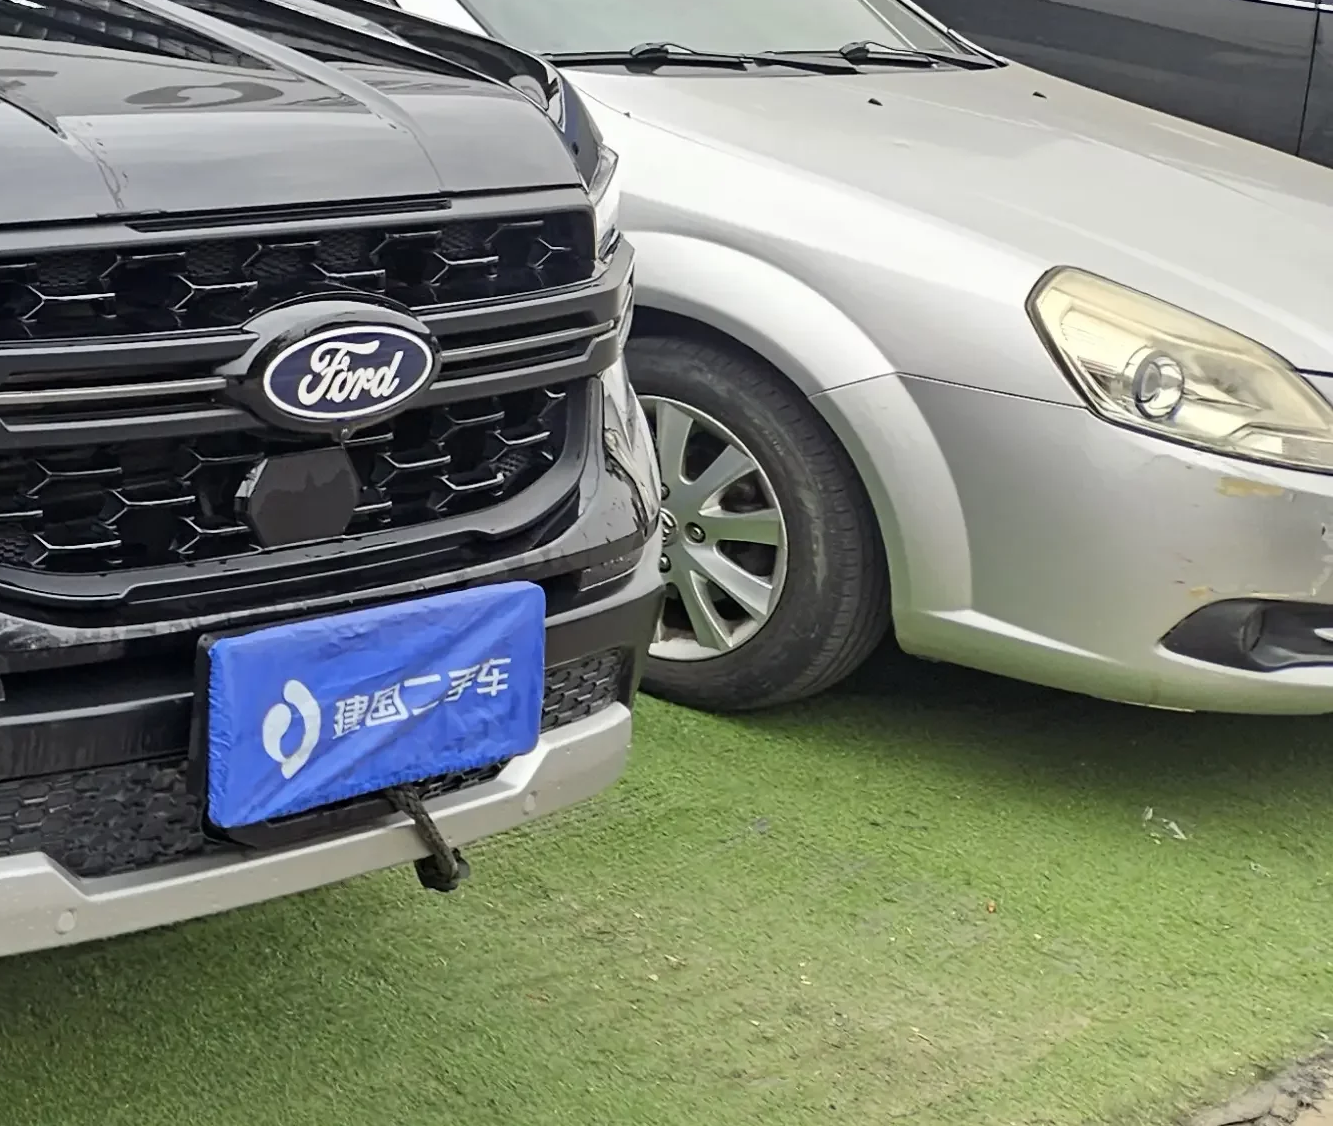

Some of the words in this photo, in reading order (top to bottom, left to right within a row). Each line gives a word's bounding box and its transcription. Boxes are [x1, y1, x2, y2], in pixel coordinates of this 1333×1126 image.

[297, 339, 401, 406] Ford
[332, 657, 511, 740] 建国二手车
